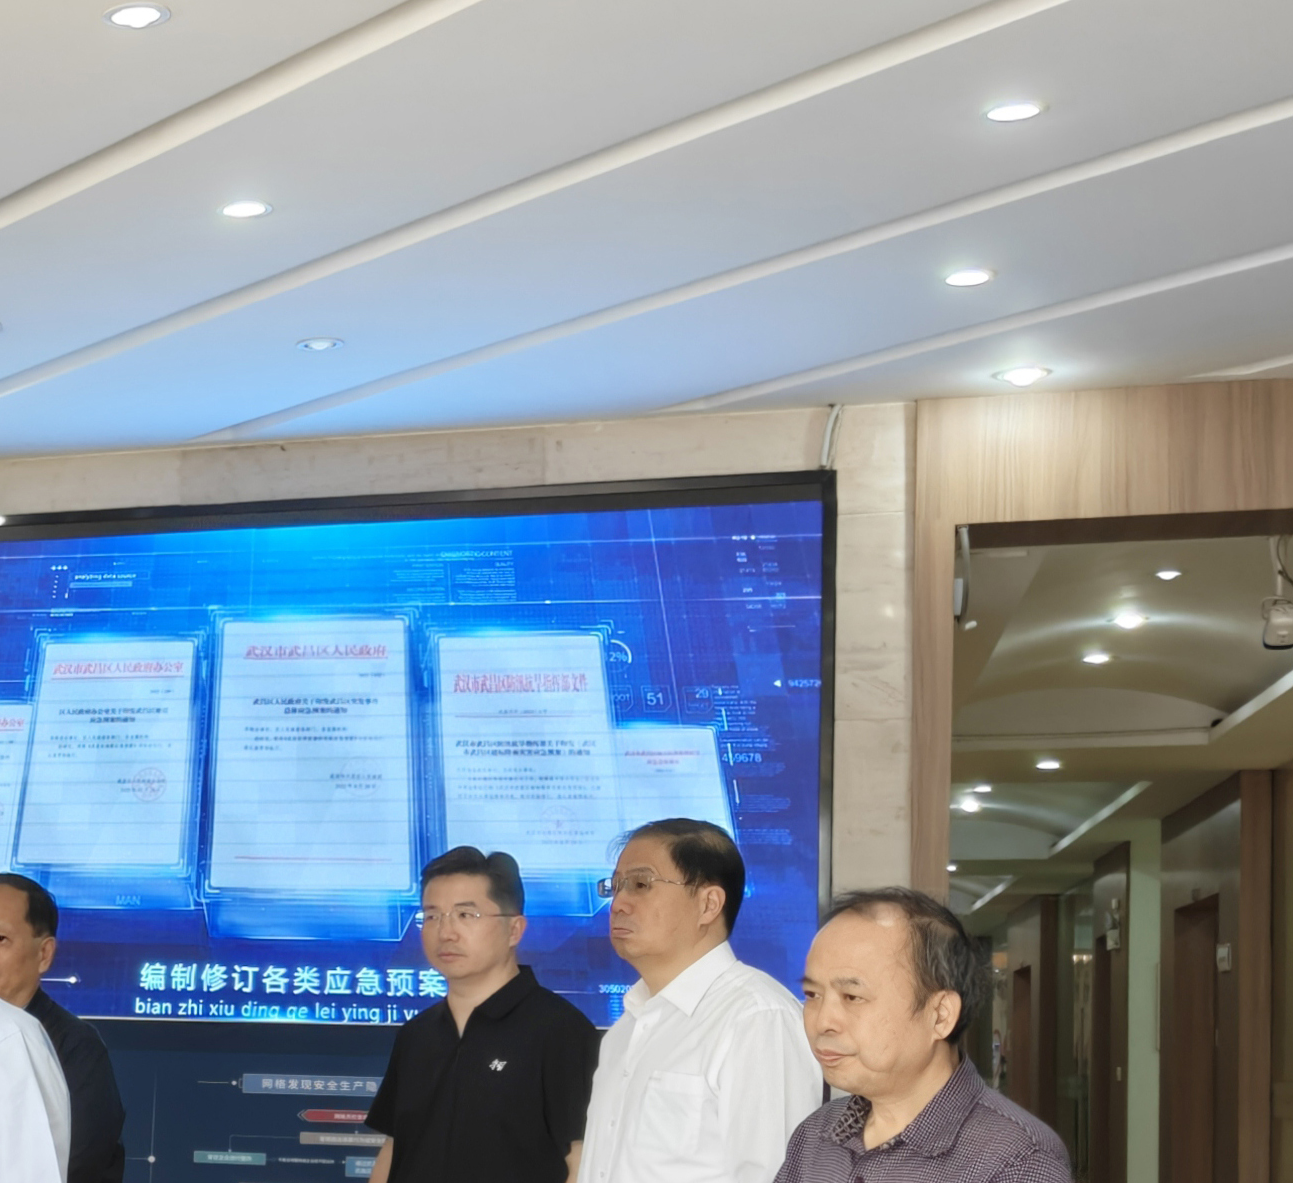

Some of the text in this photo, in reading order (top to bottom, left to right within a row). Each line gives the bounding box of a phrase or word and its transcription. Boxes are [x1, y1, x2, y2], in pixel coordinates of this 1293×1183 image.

[245, 644, 387, 658] 武汉市武昌区人民政府
[52, 661, 185, 675] 武汉市武昌区人民政府办公室
[646, 692, 664, 706] 51
[139, 962, 448, 998] 编制修订各类应急预案
[135, 998, 172, 1015] bian
[177, 999, 203, 1016] zhi
[209, 1000, 235, 1016] xiu
[315, 1003, 336, 1020] lei
[341, 1003, 380, 1023] ying
